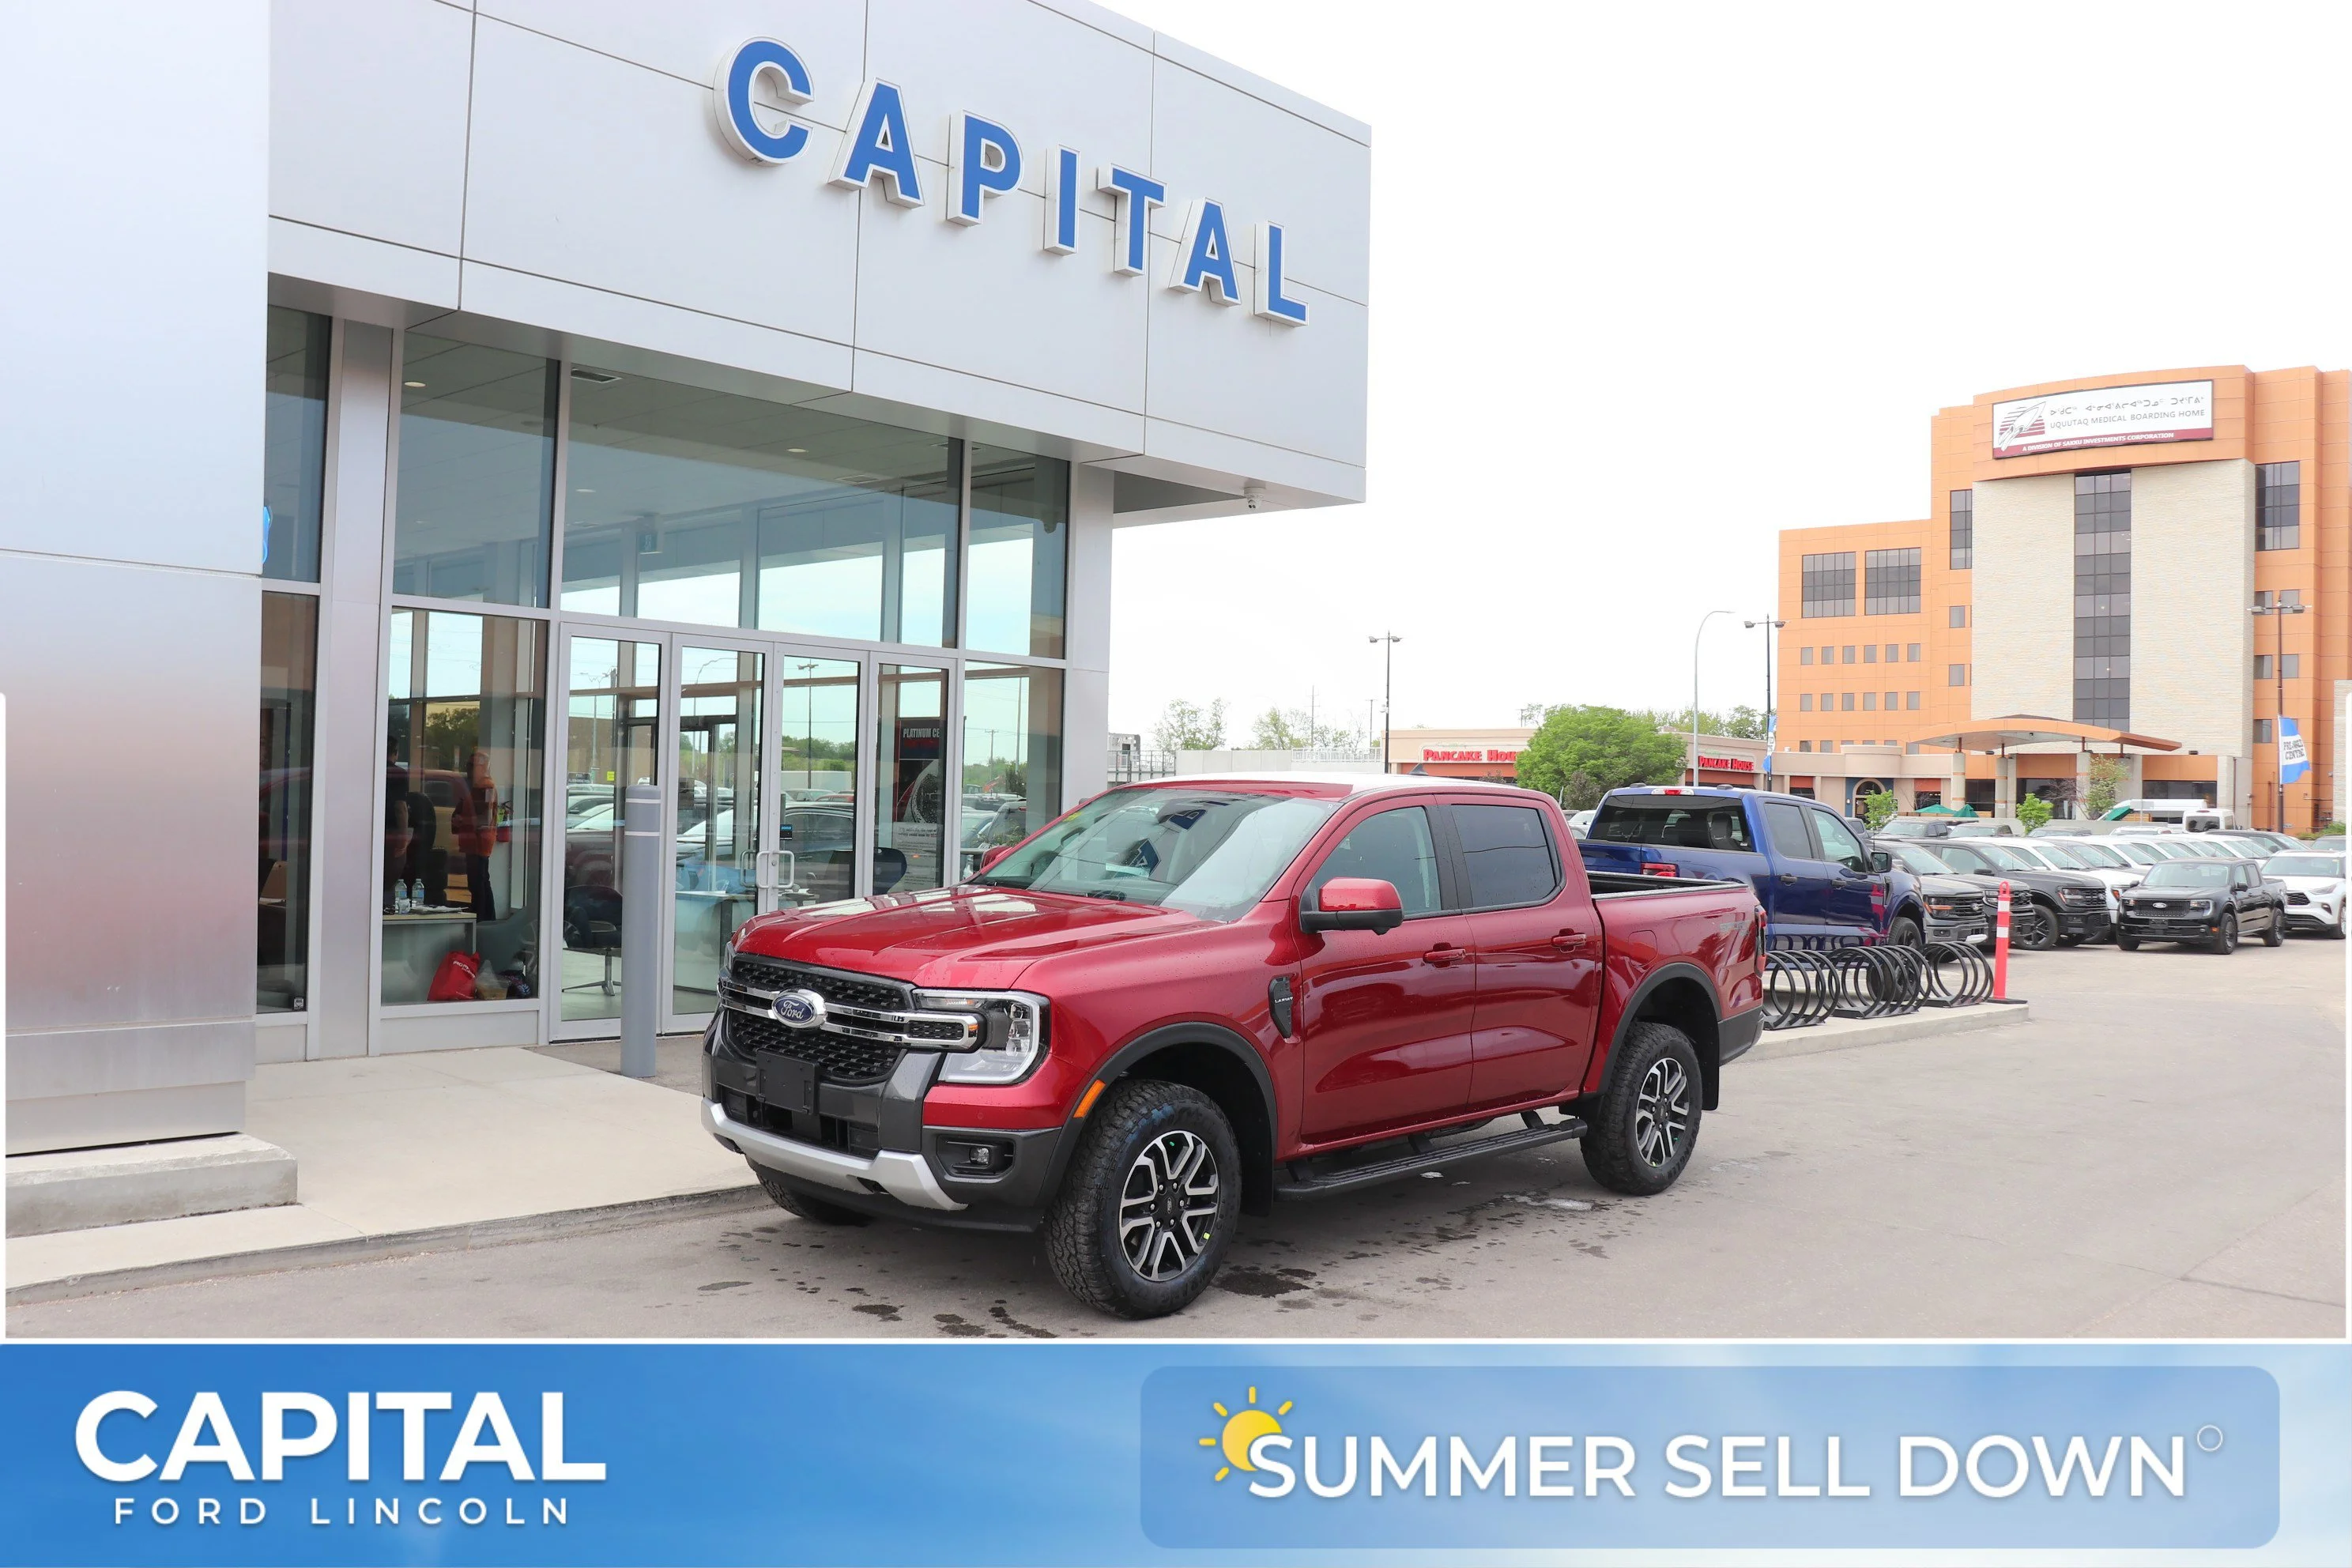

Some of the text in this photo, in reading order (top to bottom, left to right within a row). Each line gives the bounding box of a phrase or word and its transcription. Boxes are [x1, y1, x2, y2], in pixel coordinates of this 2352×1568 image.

[713, 36, 1310, 327] CAPITAL
[2050, 418, 2089, 428] UQUUTAQ
[2090, 415, 2127, 424] MEDICAL
[2130, 411, 2176, 420] BOARDING
[2082, 435, 2126, 444] INVESTMENTS
[2127, 432, 2174, 441] CORPORATION
[903, 728, 932, 738] PLATINUM
[1423, 748, 1517, 762] PANCAKE HOU
[1698, 756, 1754, 771] PANCAKE HOUSE
